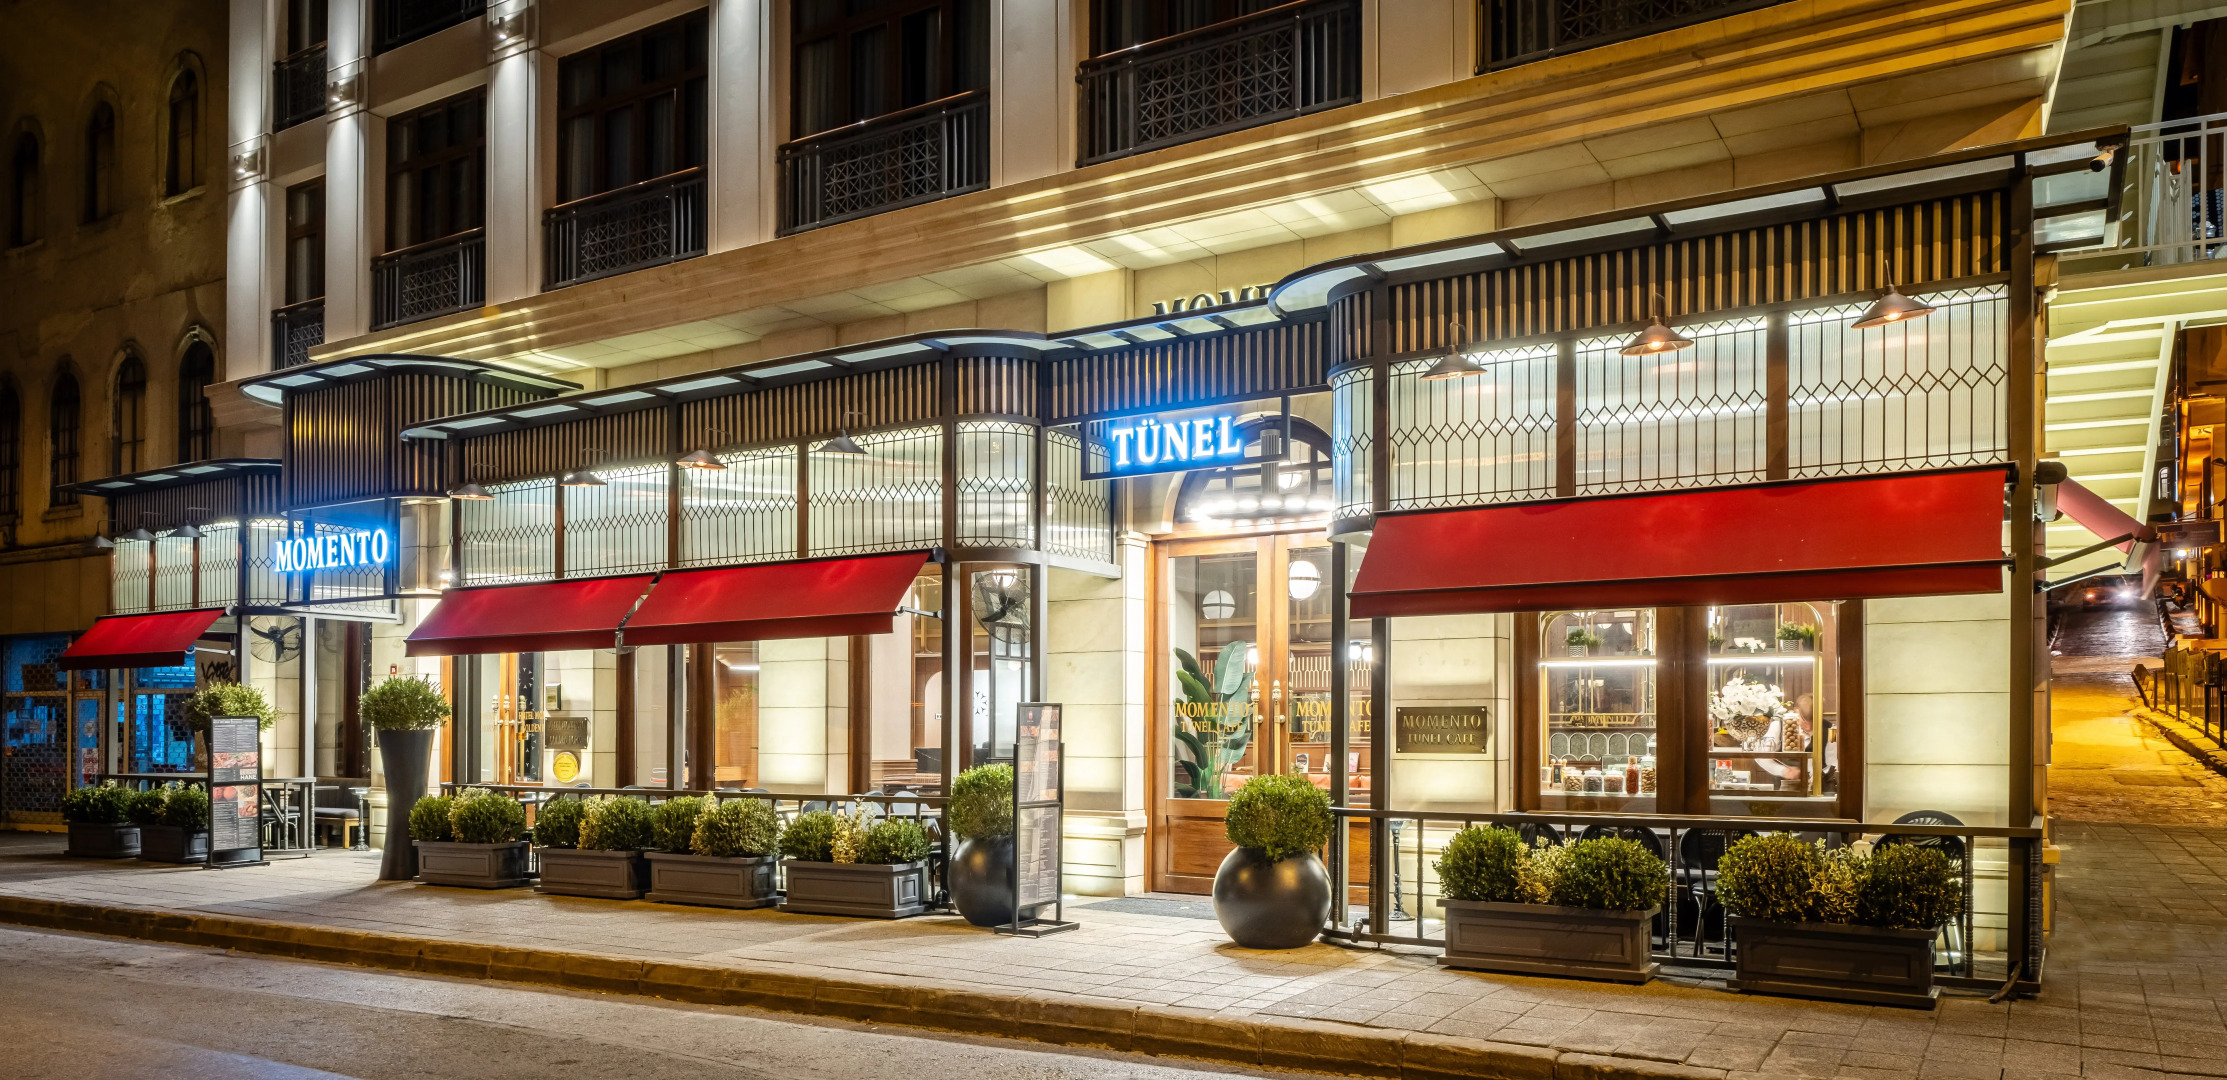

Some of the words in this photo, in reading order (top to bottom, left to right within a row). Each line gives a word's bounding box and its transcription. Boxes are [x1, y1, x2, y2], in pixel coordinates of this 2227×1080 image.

[1112, 416, 1241, 466] TÜNEL
[274, 528, 389, 572] MOMENTO
[1175, 701, 1250, 718] MOMENTO
[1296, 700, 1371, 717] MOMNTO
[1349, 719, 1371, 732] AFE
[1402, 714, 1481, 729] MOMENTO
